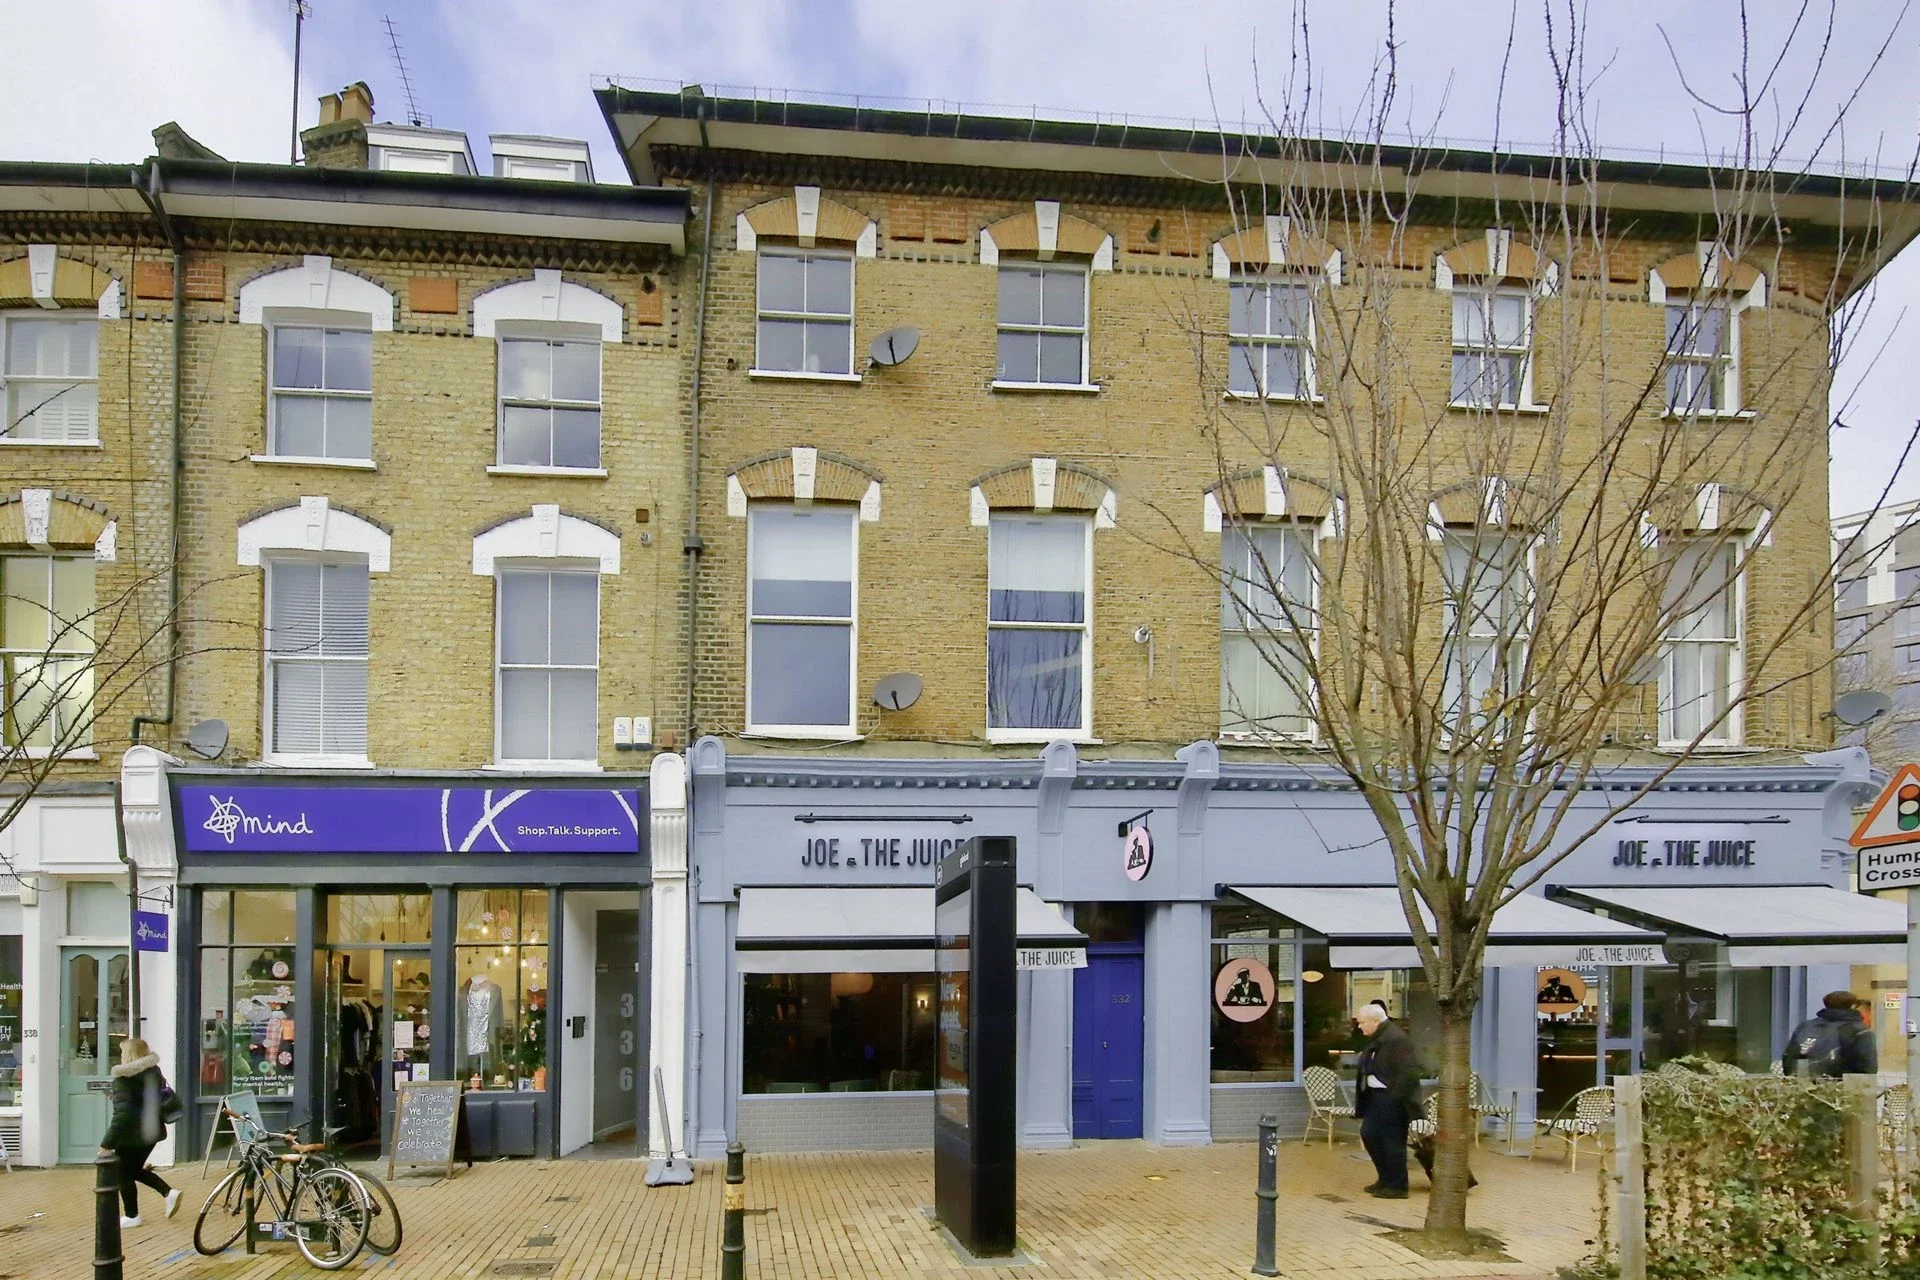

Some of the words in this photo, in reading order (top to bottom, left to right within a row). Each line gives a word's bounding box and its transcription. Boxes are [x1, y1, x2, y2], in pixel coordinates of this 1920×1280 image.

[243, 812, 314, 834] mind
[801, 838, 840, 867] JOE
[846, 857, 858, 867] &
[860, 838, 901, 867] THE
[906, 838, 964, 867] JUIC
[1612, 840, 1649, 867] JOE
[1664, 840, 1701, 867] THE
[1703, 840, 1757, 867] JUICE
[1021, 951, 1042, 967] THE
[1045, 950, 1078, 966] JUICE
[1576, 947, 1596, 962] JOE
[1603, 947, 1623, 962] THE
[1625, 946, 1656, 961] JUICE
[23, 1029, 38, 1038] 338
[420, 1092, 454, 1105] Together
[411, 1116, 445, 1127] Together
